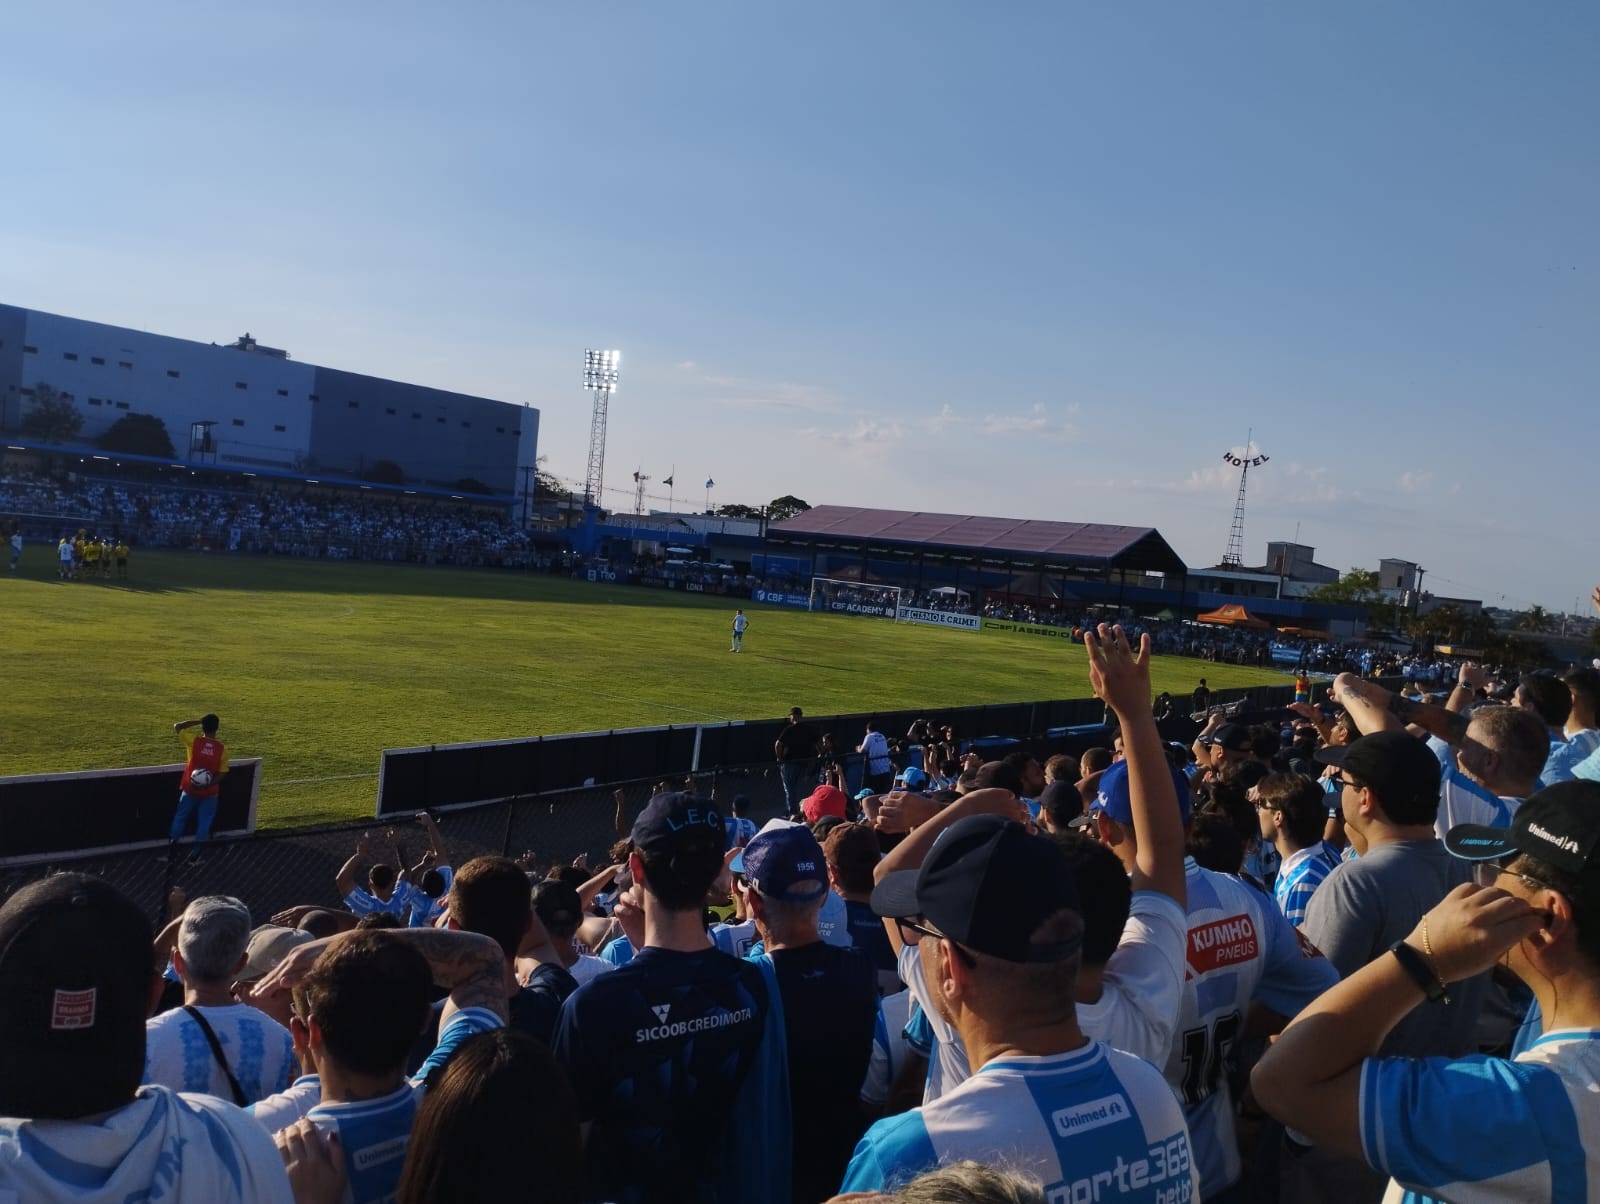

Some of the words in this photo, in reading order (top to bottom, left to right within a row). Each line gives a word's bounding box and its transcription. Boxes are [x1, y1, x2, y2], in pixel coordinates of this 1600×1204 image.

[1223, 452, 1270, 467] HOTEL
[767, 592, 784, 602] CBF
[832, 602, 847, 610] CBF
[847, 602, 884, 615] ACADEMY
[899, 608, 939, 622] RACISMO
[947, 616, 977, 627] CRIME!
[1528, 822, 1565, 847] Unimed
[797, 862, 815, 872] 1956
[1192, 918, 1253, 953] KUMHO
[1216, 940, 1255, 962] PNEUS
[1059, 1106, 1107, 1129] Unimed
